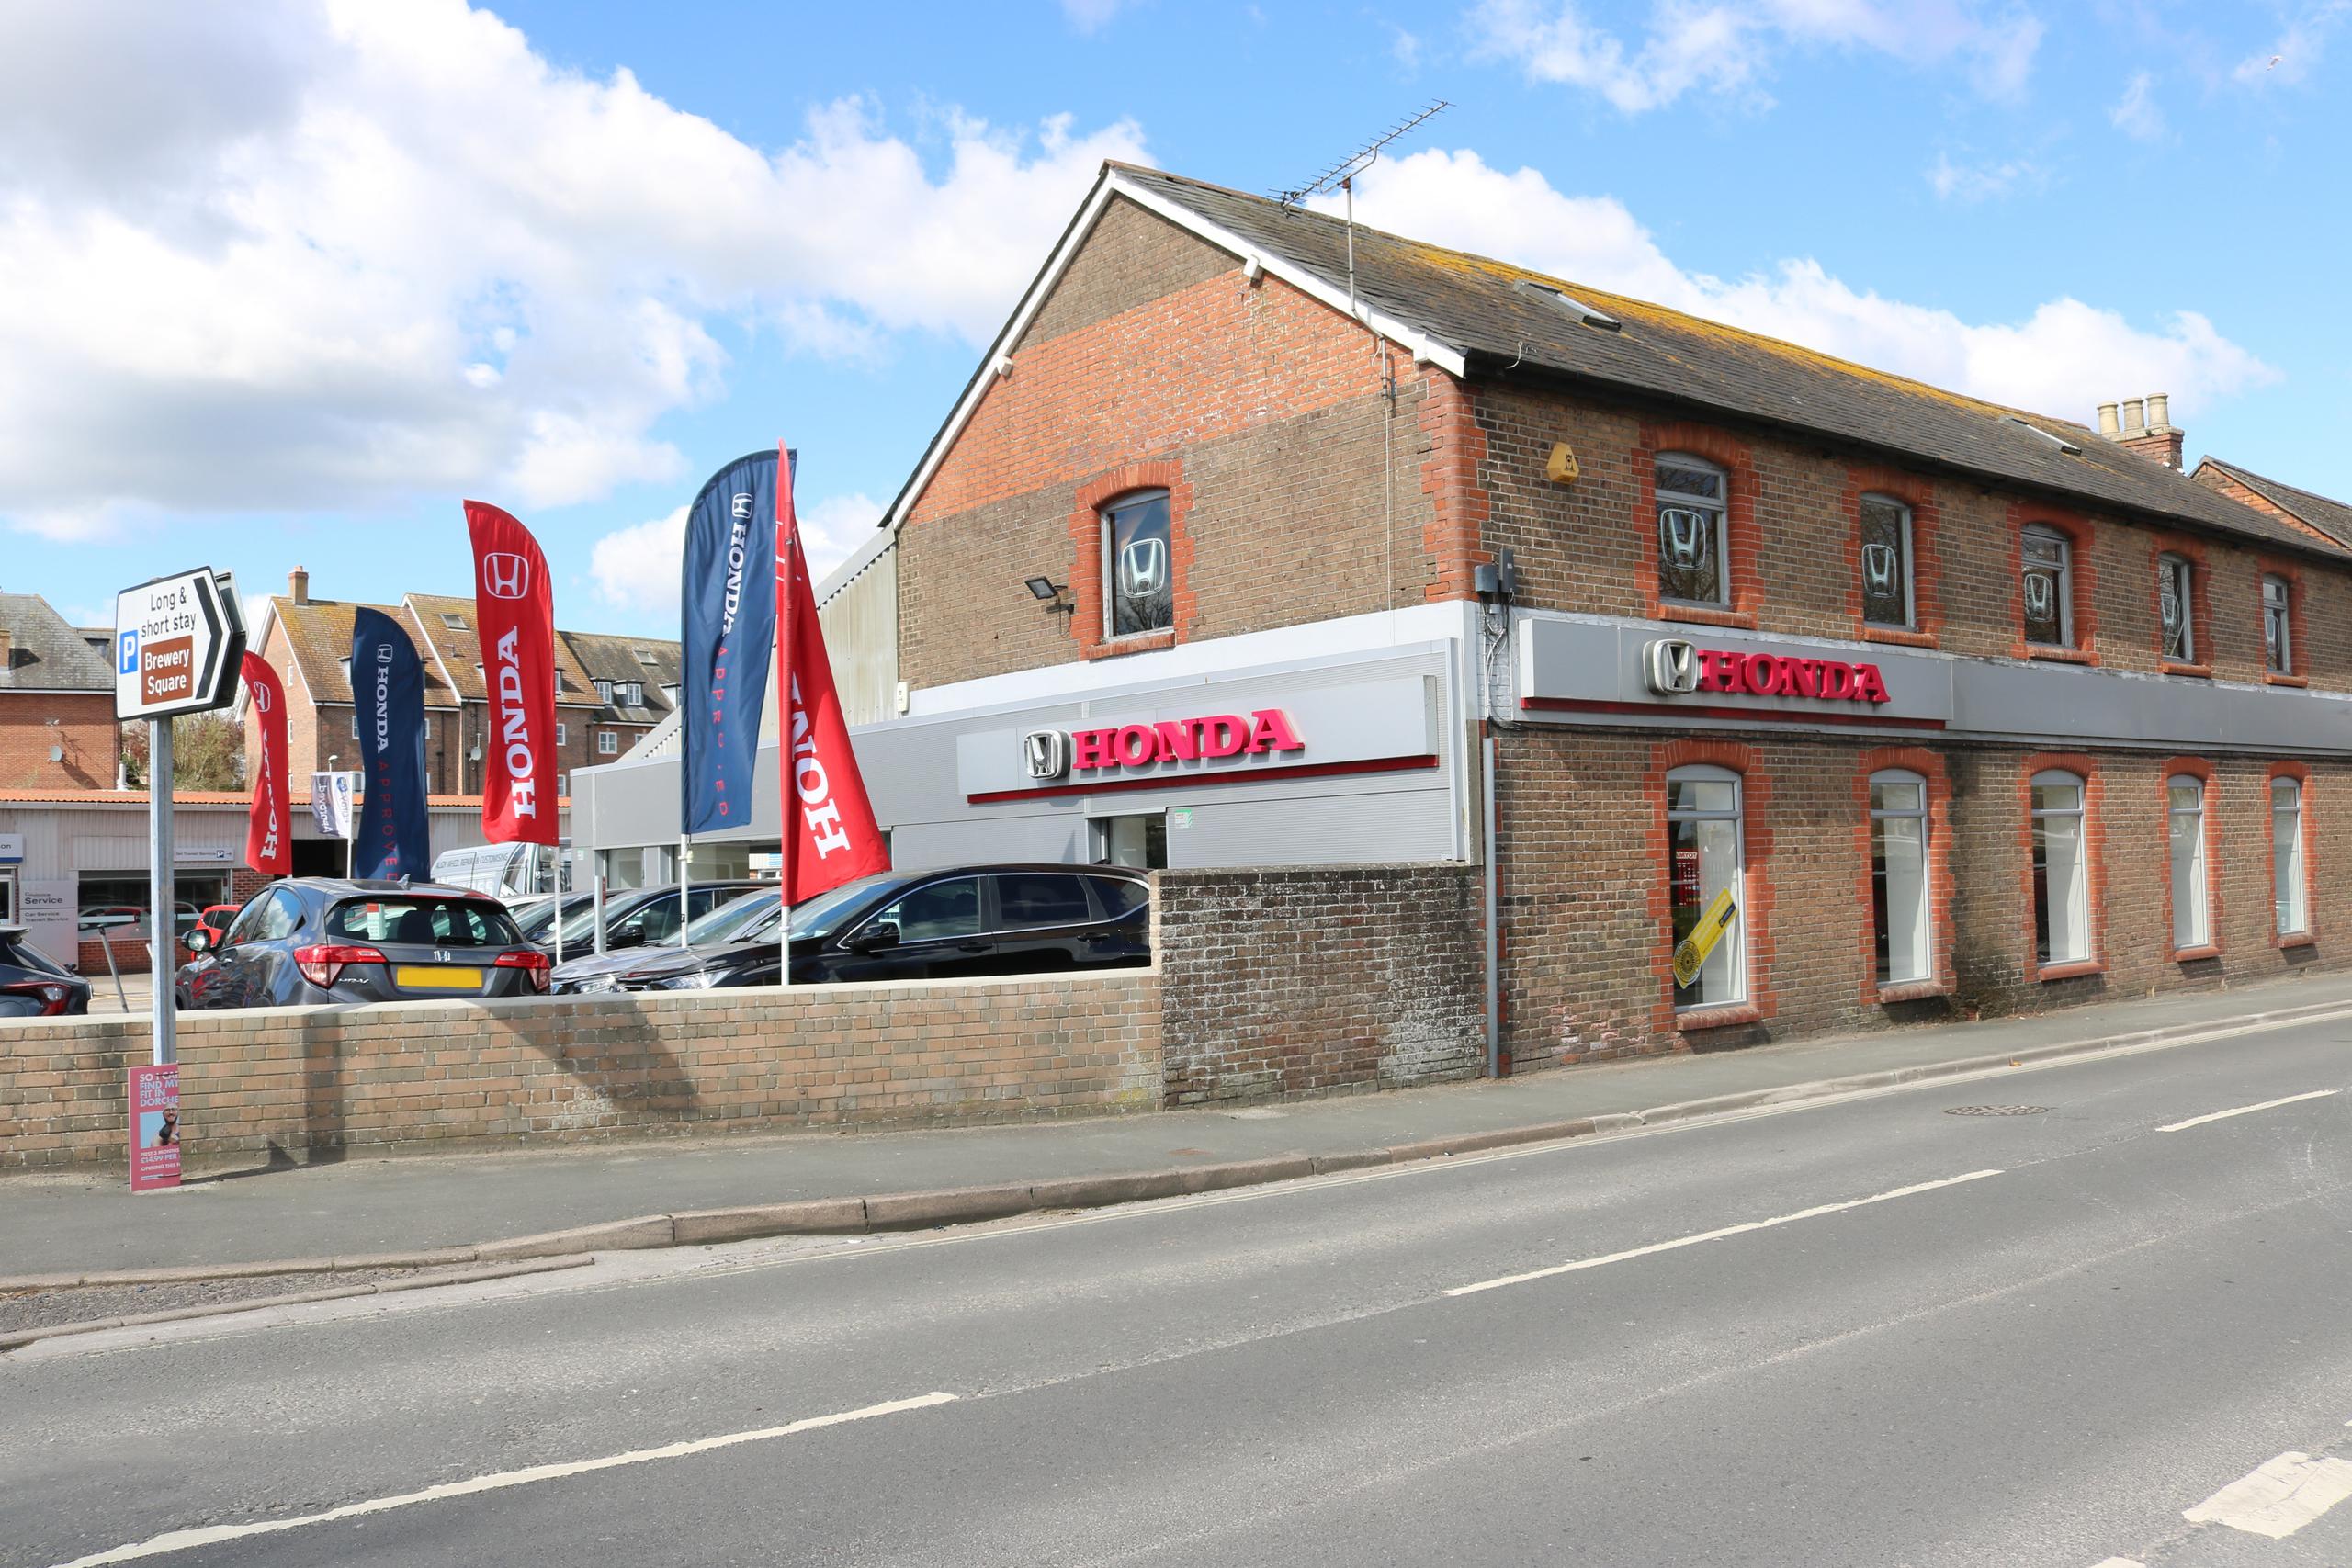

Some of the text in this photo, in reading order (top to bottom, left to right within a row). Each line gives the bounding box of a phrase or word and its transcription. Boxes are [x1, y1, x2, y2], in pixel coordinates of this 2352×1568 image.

[722, 522, 747, 637] HONDA
[151, 586, 187, 612] Long &
[141, 612, 197, 638] short stay
[123, 636, 136, 670] P
[144, 648, 189, 671] Brewery
[147, 674, 187, 697] Square
[1697, 649, 1891, 703] HONDA
[376, 666, 389, 753] HONDA
[498, 626, 536, 819] HONDA
[1071, 708, 1306, 770] HONDA
[25, 897, 63, 905] Service
[140, 1073, 153, 1082] SO
[140, 1080, 163, 1090] FIND
[140, 1088, 165, 1099] FIT IN
